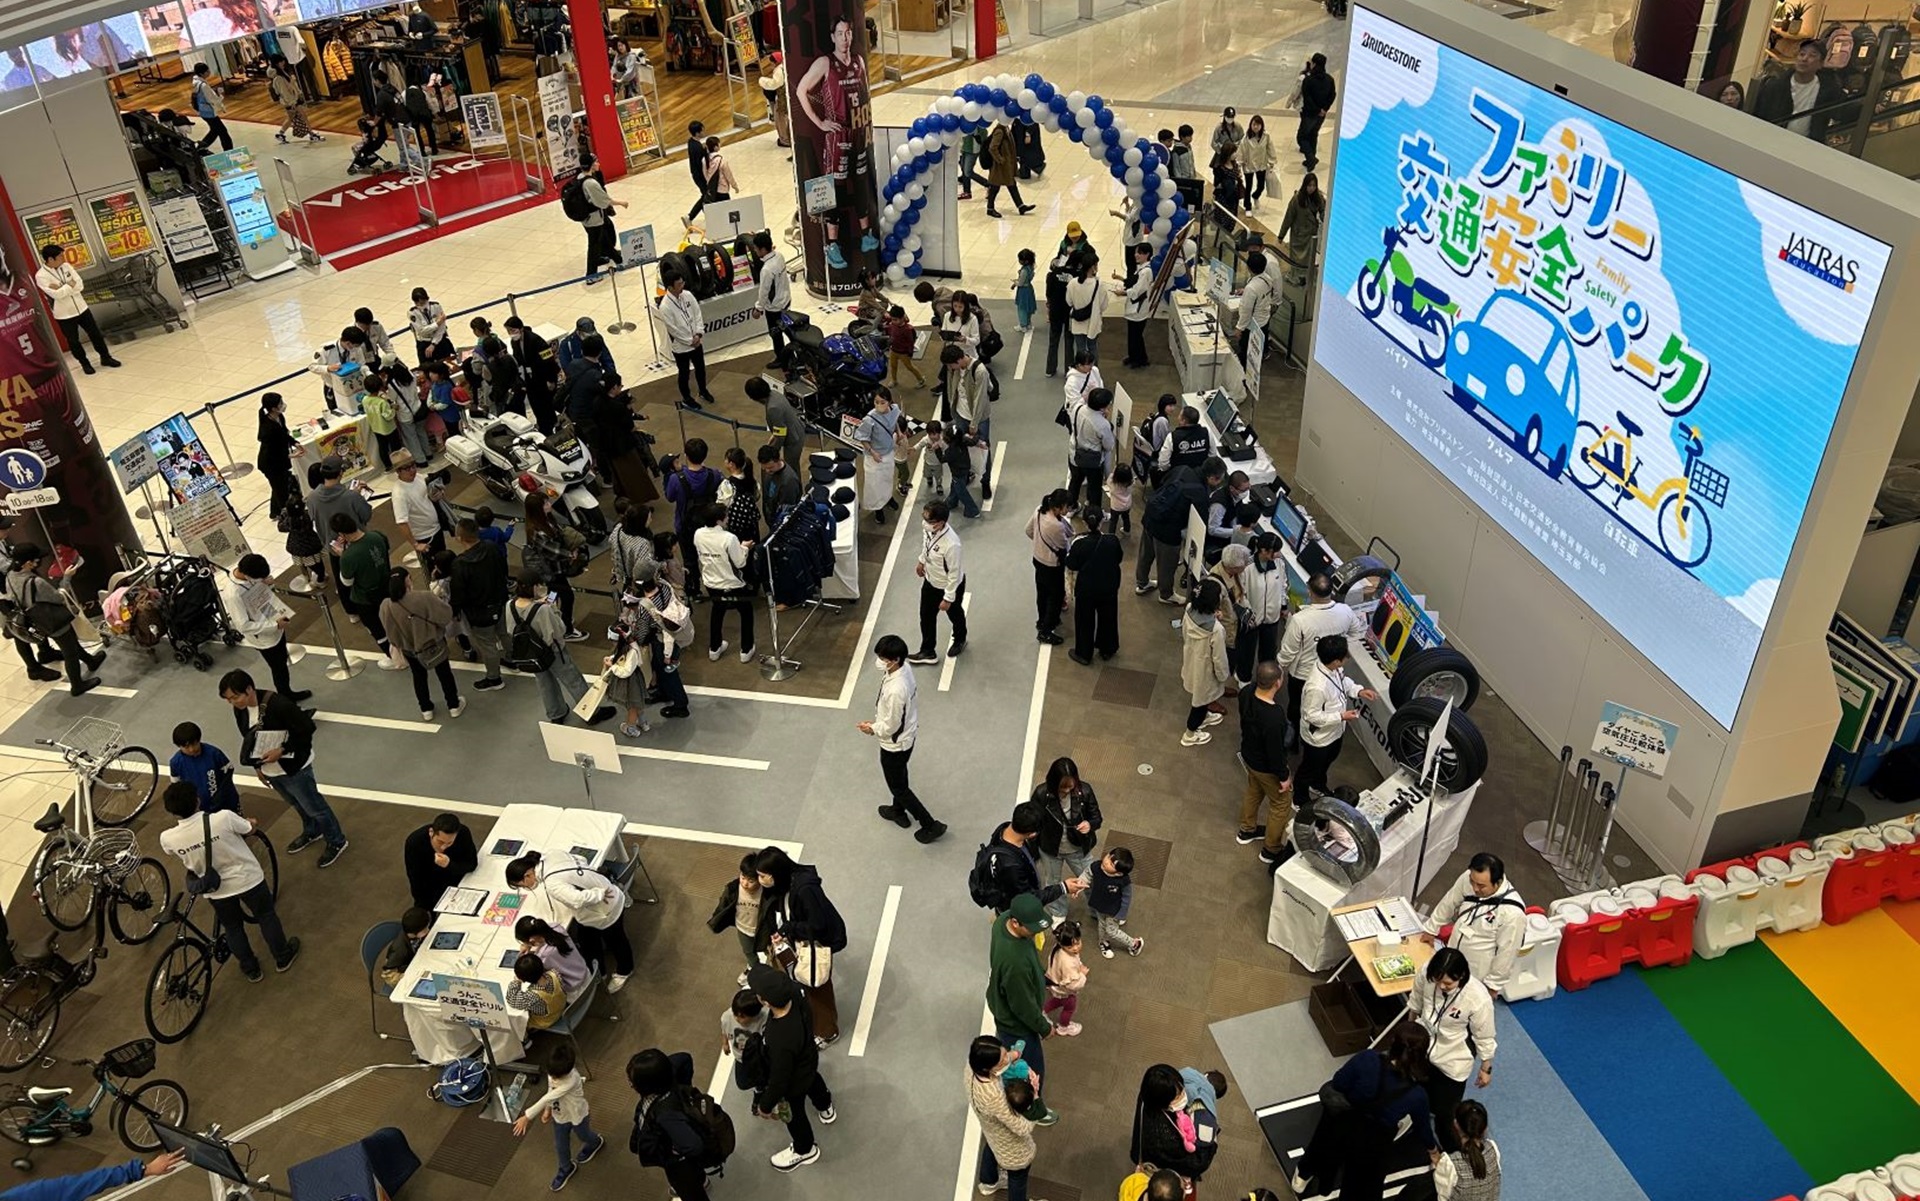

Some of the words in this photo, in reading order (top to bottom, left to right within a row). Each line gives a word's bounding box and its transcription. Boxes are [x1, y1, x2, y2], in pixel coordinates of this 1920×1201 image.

[1361, 31, 1422, 73] BRIDGESTONE
[302, 158, 485, 208] Victoria
[1472, 91, 1651, 254] ファミリー
[112, 211, 142, 230] SALE
[48, 229, 81, 246] SALE
[120, 229, 141, 250] 10
[1400, 133, 1704, 405] 交通安全パーク
[1781, 231, 1860, 285] JATRAS
[1596, 256, 1632, 296] Family
[1584, 279, 1617, 308] Safety
[703, 307, 764, 335] RIDGEST
[18, 333, 34, 356] 5
[1385, 347, 1409, 369] バイク
[1190, 440, 1206, 449] JAF
[1487, 435, 1514, 464] クルマ
[1603, 520, 1639, 558] 自転車
[1602, 726, 1667, 755] 空気圧比較体験
[1607, 722, 1665, 747] タイヤごろごろ
[1615, 740, 1648, 755] コーナー
[440, 996, 504, 1012] 交通安全ドリル
[457, 990, 483, 1000] うんこ
[459, 1006, 489, 1015] コーナー
